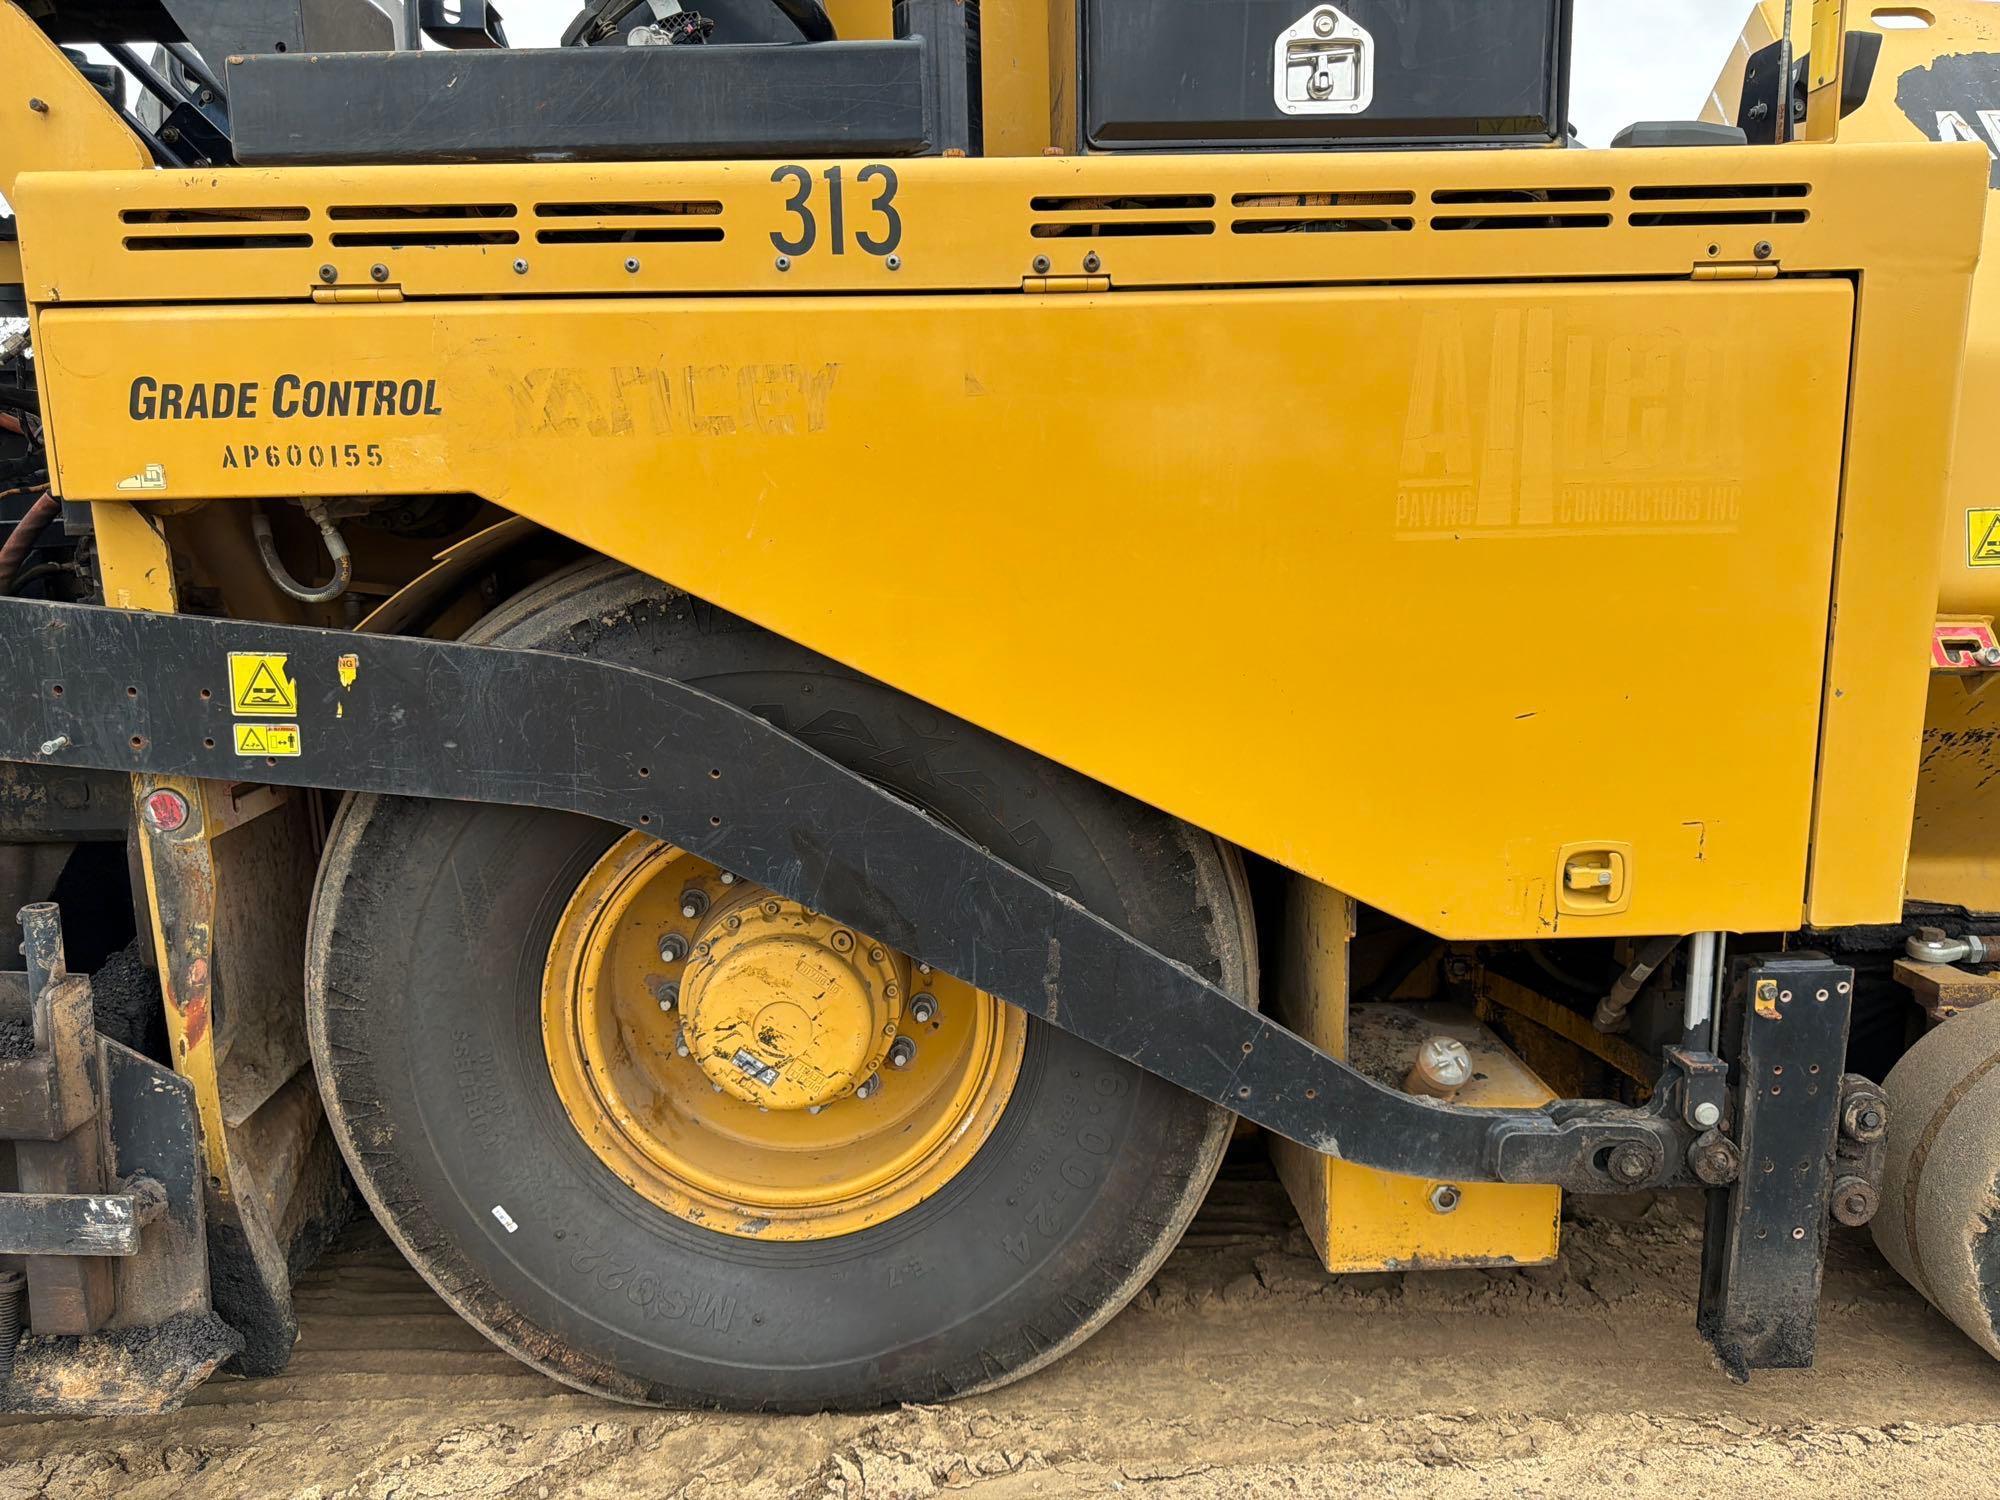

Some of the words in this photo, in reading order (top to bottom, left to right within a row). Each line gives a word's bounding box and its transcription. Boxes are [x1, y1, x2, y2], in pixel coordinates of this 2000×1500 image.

[769, 164, 902, 256] 313
[129, 376, 259, 420] GRADE
[272, 374, 442, 418] CONTROL
[222, 445, 383, 468] AP600155
[1395, 491, 1475, 527] PAVING
[1560, 488, 1701, 523] CONTRACTORS
[1706, 486, 1741, 521] INC
[1003, 1071, 1130, 1265] 6.00-24
